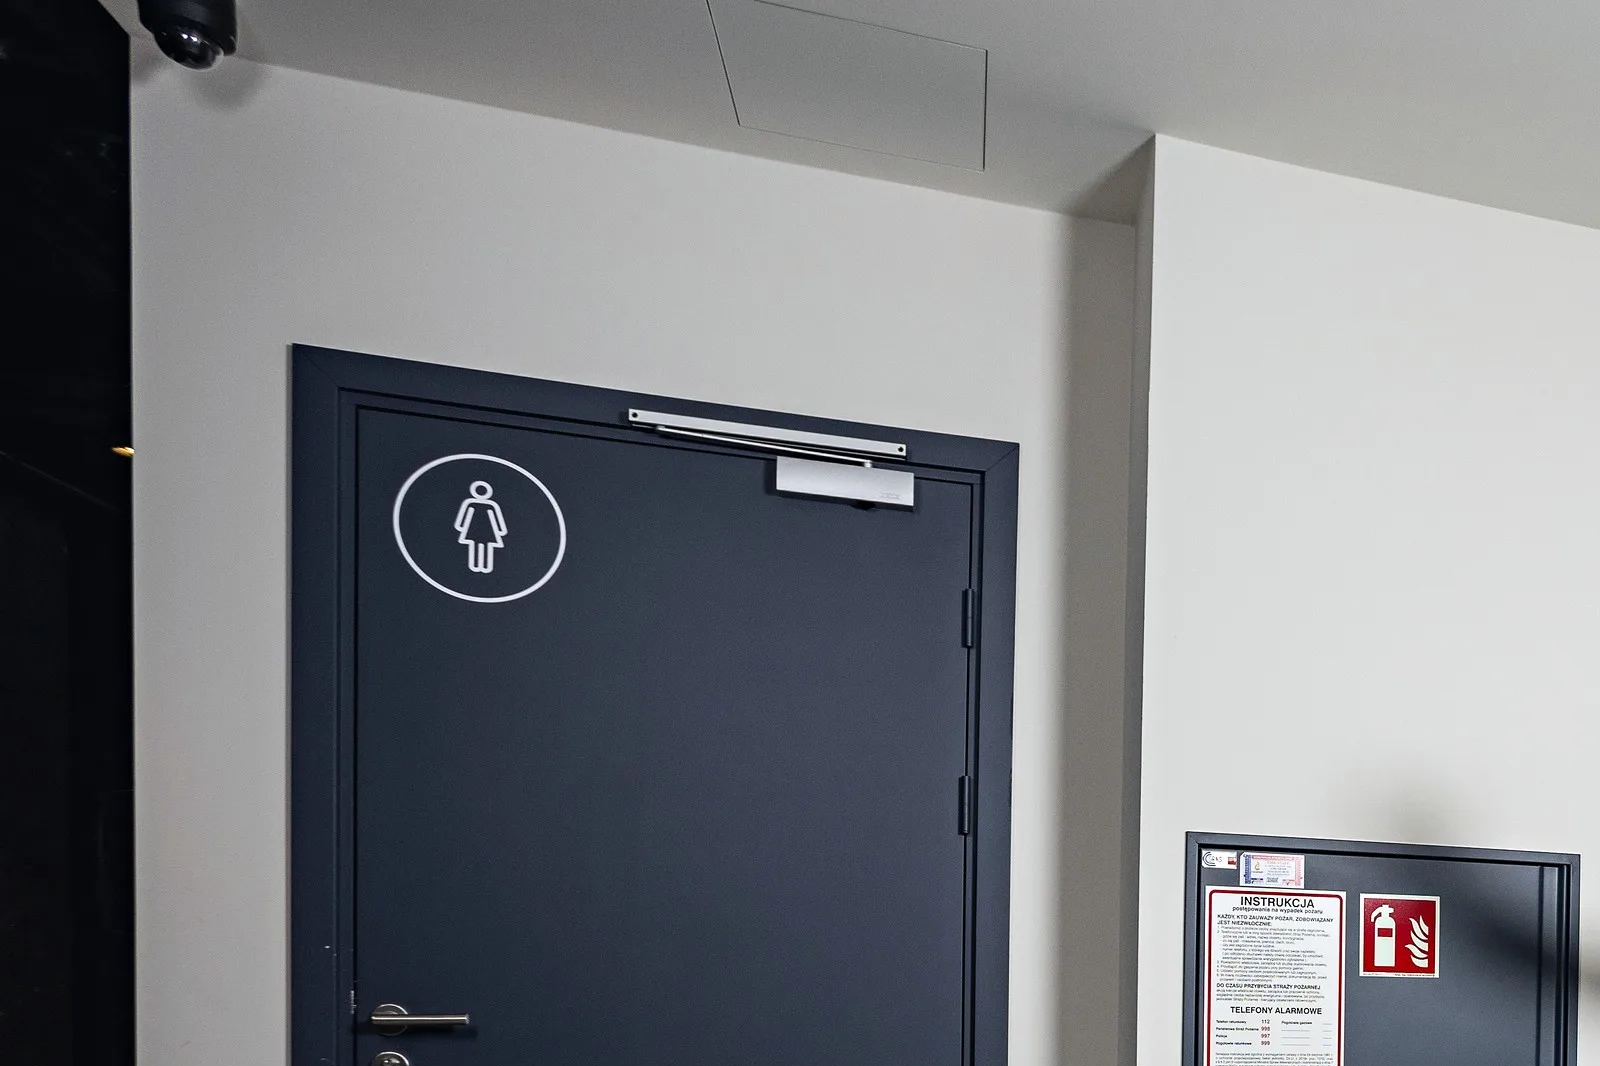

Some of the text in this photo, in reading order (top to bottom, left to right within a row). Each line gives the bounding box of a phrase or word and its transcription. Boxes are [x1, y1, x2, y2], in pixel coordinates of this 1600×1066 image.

[1240, 896, 1315, 908] INSTRUKCJA
[1230, 1006, 1322, 1015] TELEFONY ALARMOWE
